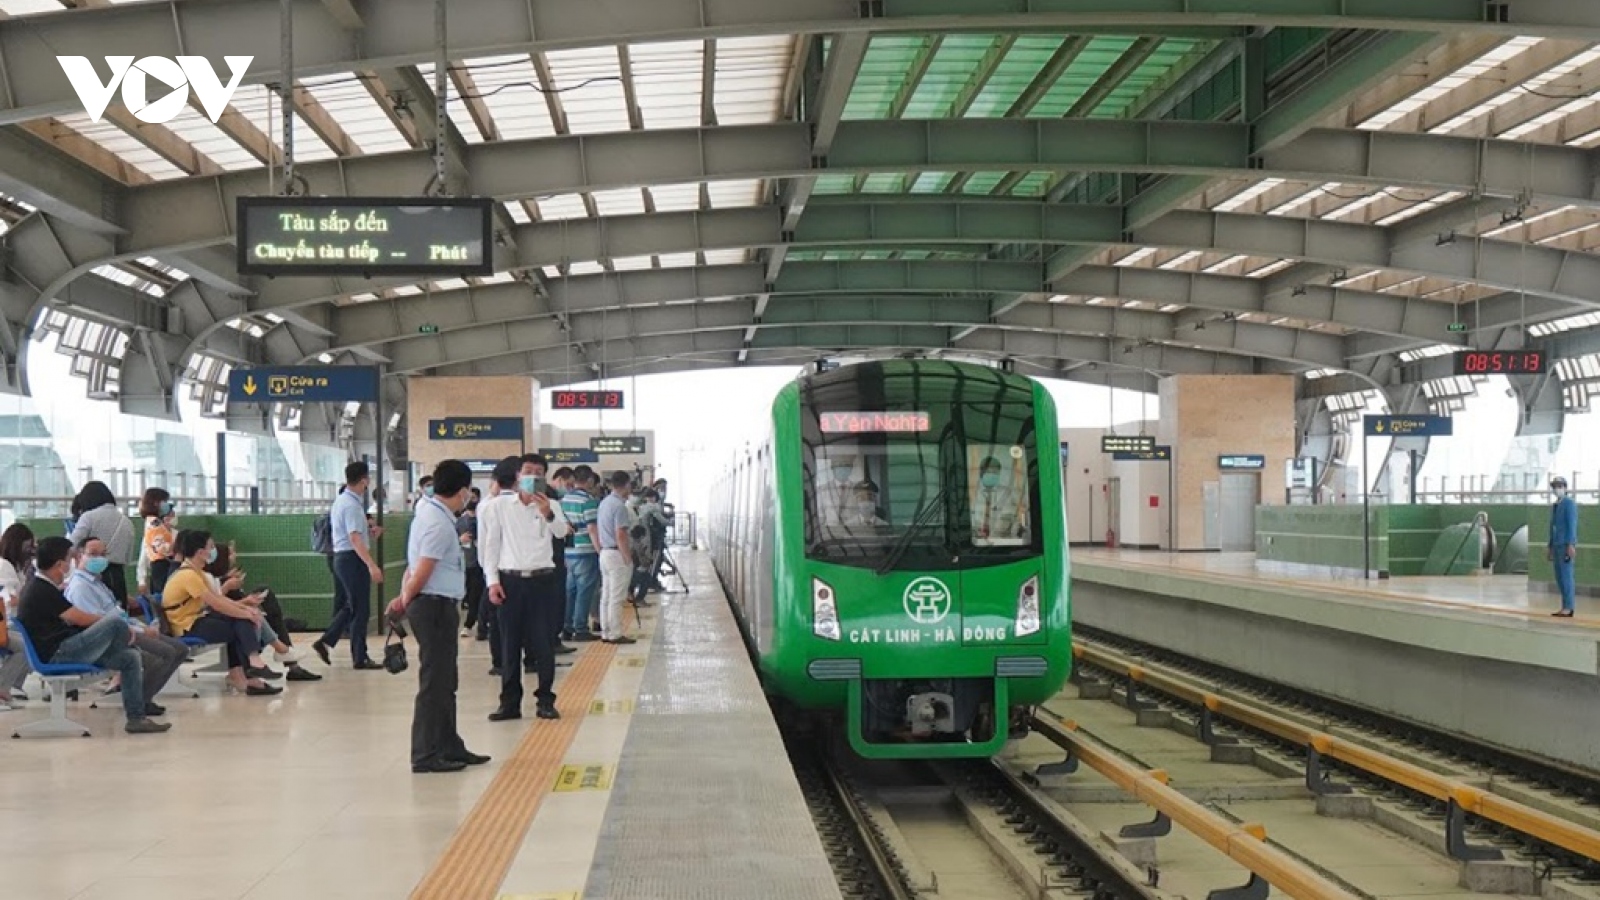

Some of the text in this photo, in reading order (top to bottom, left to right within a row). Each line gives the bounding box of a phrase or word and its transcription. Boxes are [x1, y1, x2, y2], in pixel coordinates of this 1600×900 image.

[279, 209, 388, 233] Tàu sắp đến
[255, 239, 315, 261] Chuyến
[319, 244, 345, 258] tàu
[349, 240, 379, 262] tiếp
[429, 244, 468, 260] Phút
[1465, 353, 1539, 371] 08:51:13
[316, 377, 328, 387] ra
[850, 627, 880, 643] CÁT
[885, 629, 920, 642] LINH
[935, 626, 956, 642] HÀ
